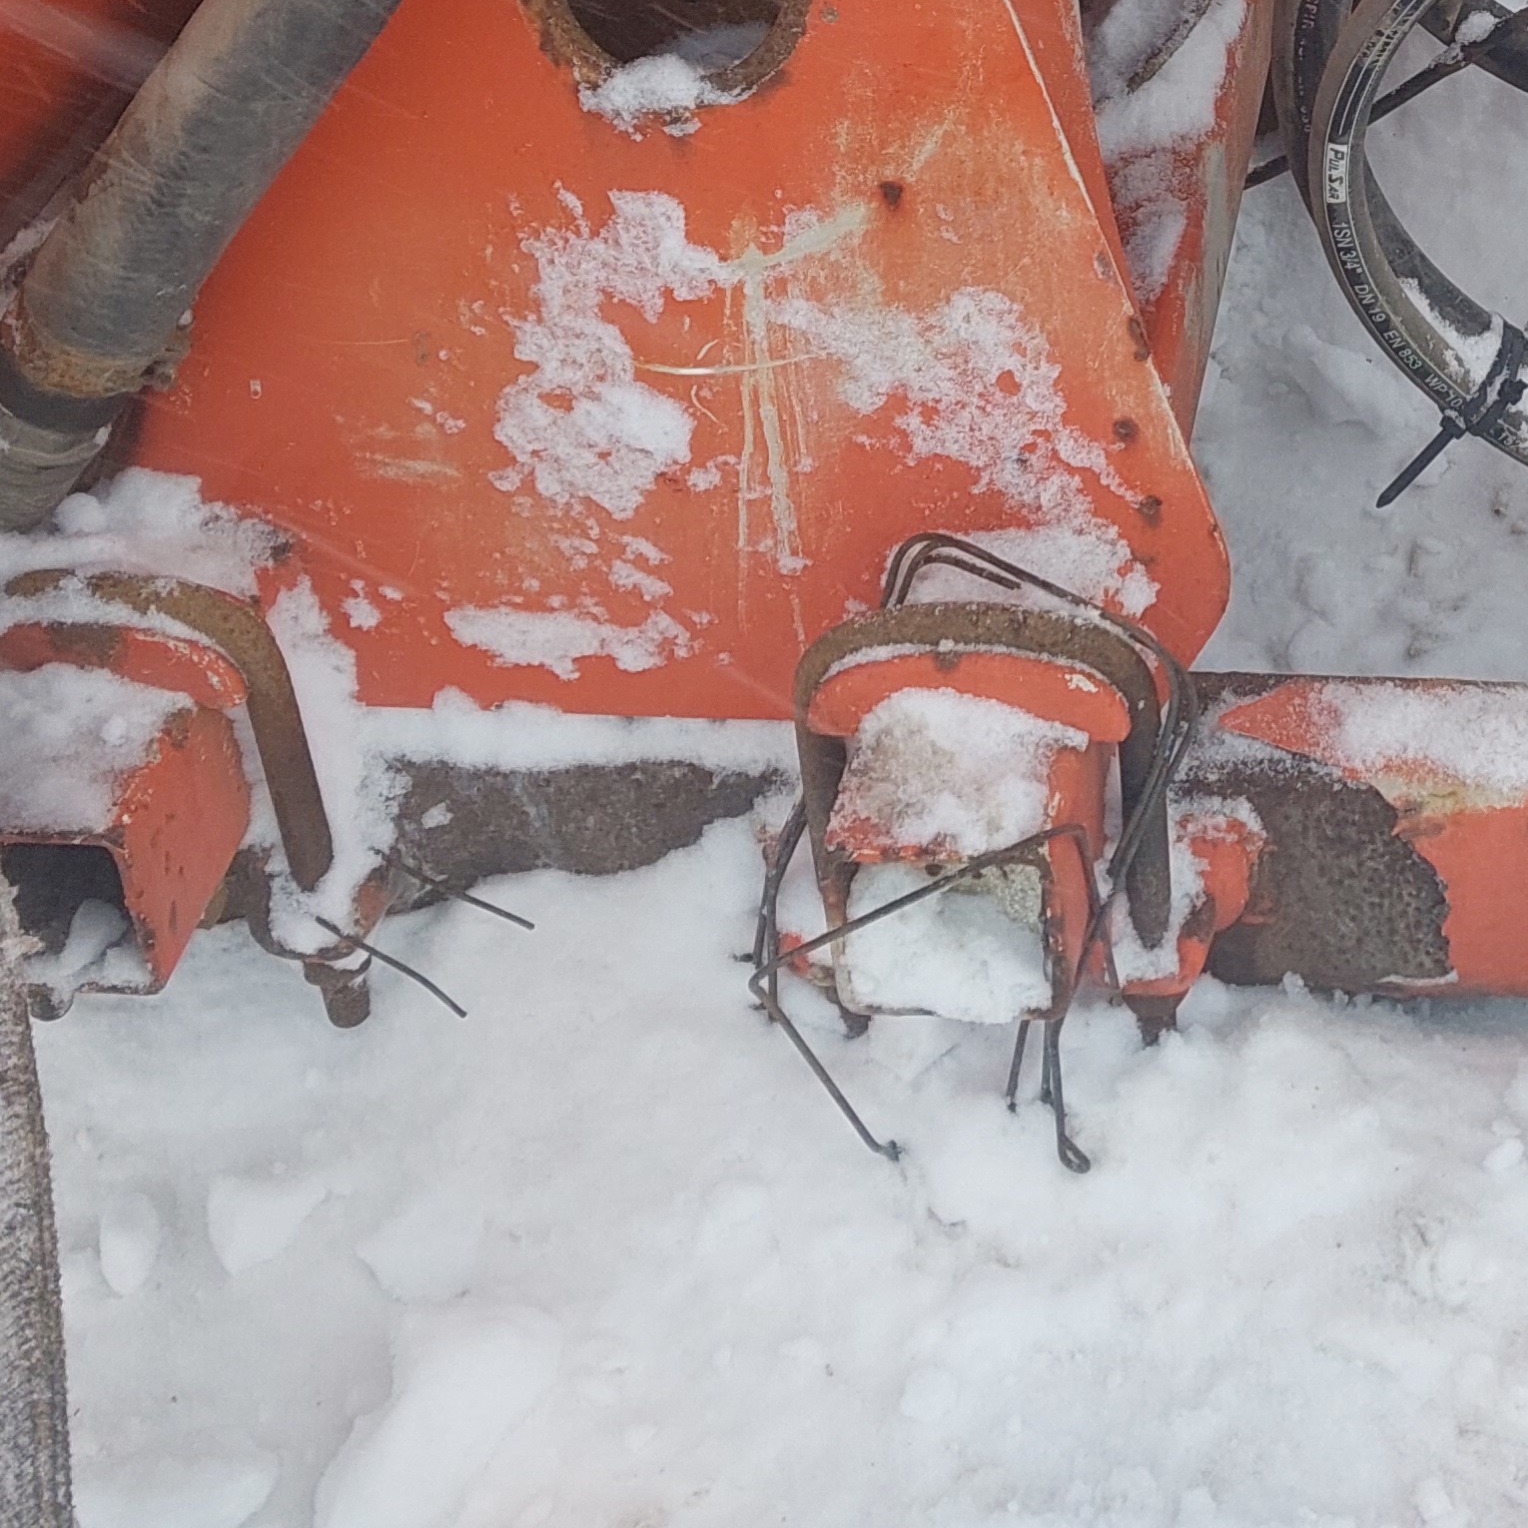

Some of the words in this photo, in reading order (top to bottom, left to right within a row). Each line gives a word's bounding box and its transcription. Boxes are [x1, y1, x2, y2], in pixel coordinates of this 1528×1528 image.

[1332, 222, 1354, 250] 1SN
[1339, 249, 1363, 274] 3/4"
[1353, 284, 1375, 305] DN
[1368, 307, 1386, 323] 19
[1383, 329, 1403, 349] EN
[1399, 347, 1422, 370] 853
[1424, 373, 1448, 392] WP
